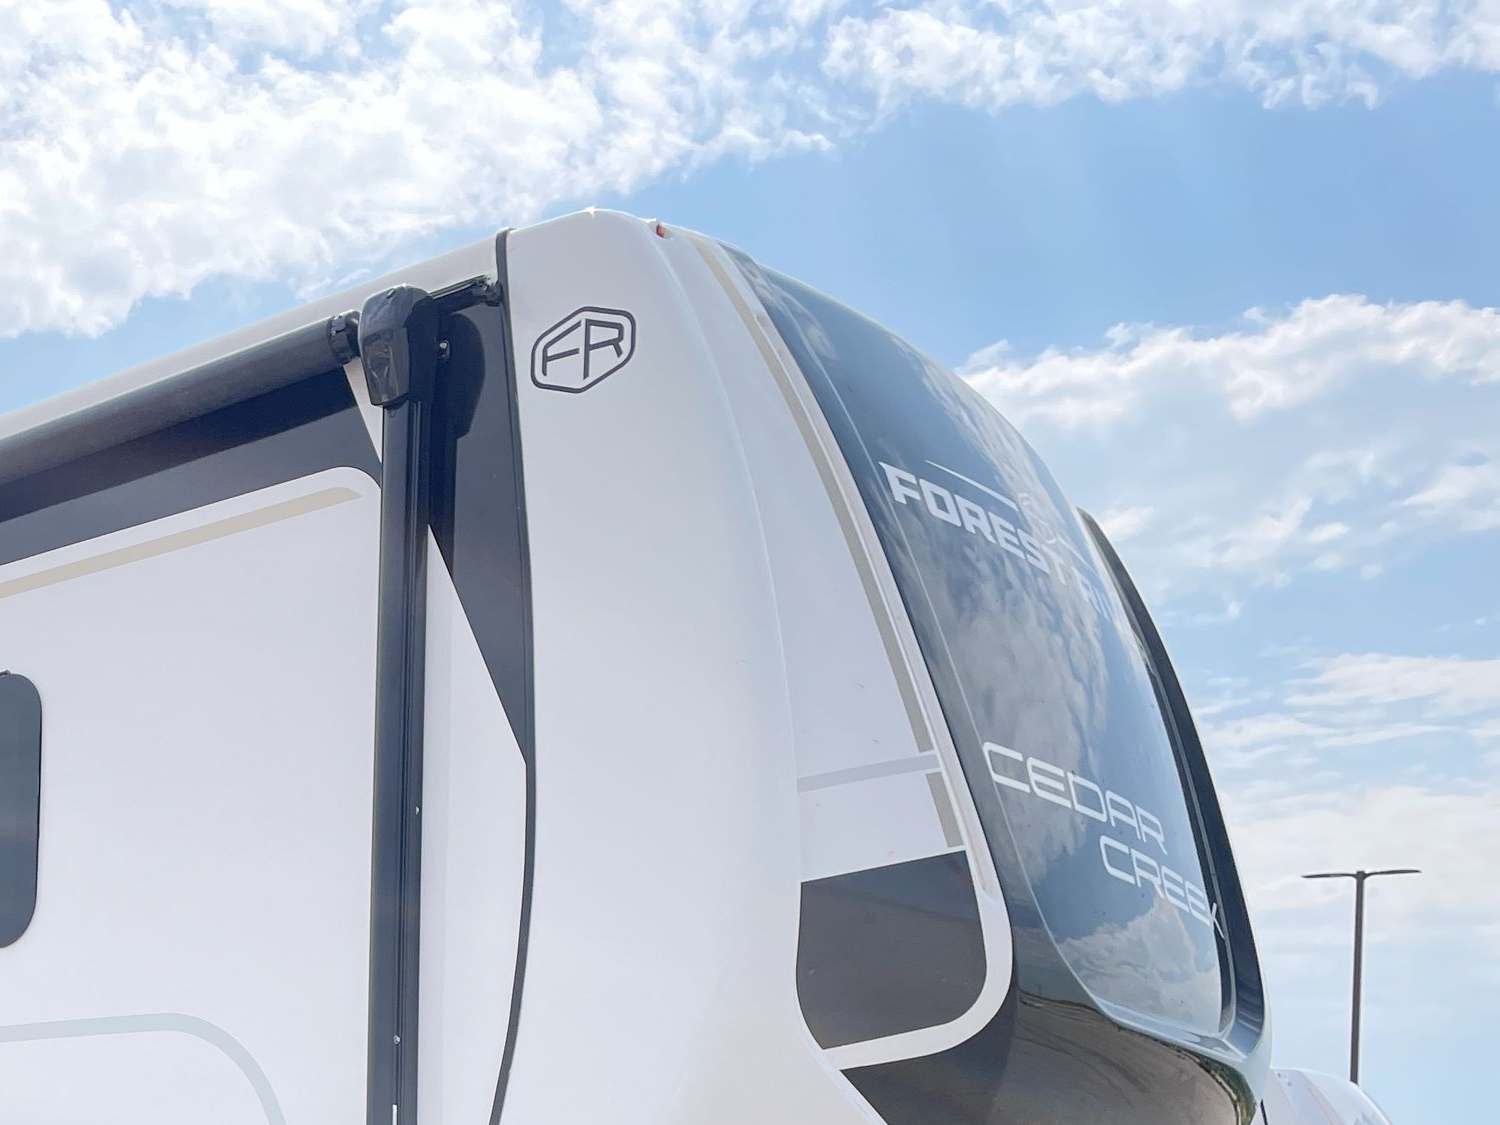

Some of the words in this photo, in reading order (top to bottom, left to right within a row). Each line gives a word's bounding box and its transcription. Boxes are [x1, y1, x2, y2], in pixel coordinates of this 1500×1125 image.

[878, 461, 1068, 587] FOREST
[982, 740, 1169, 856] CEDAR
[1099, 834, 1227, 940] CREEK
